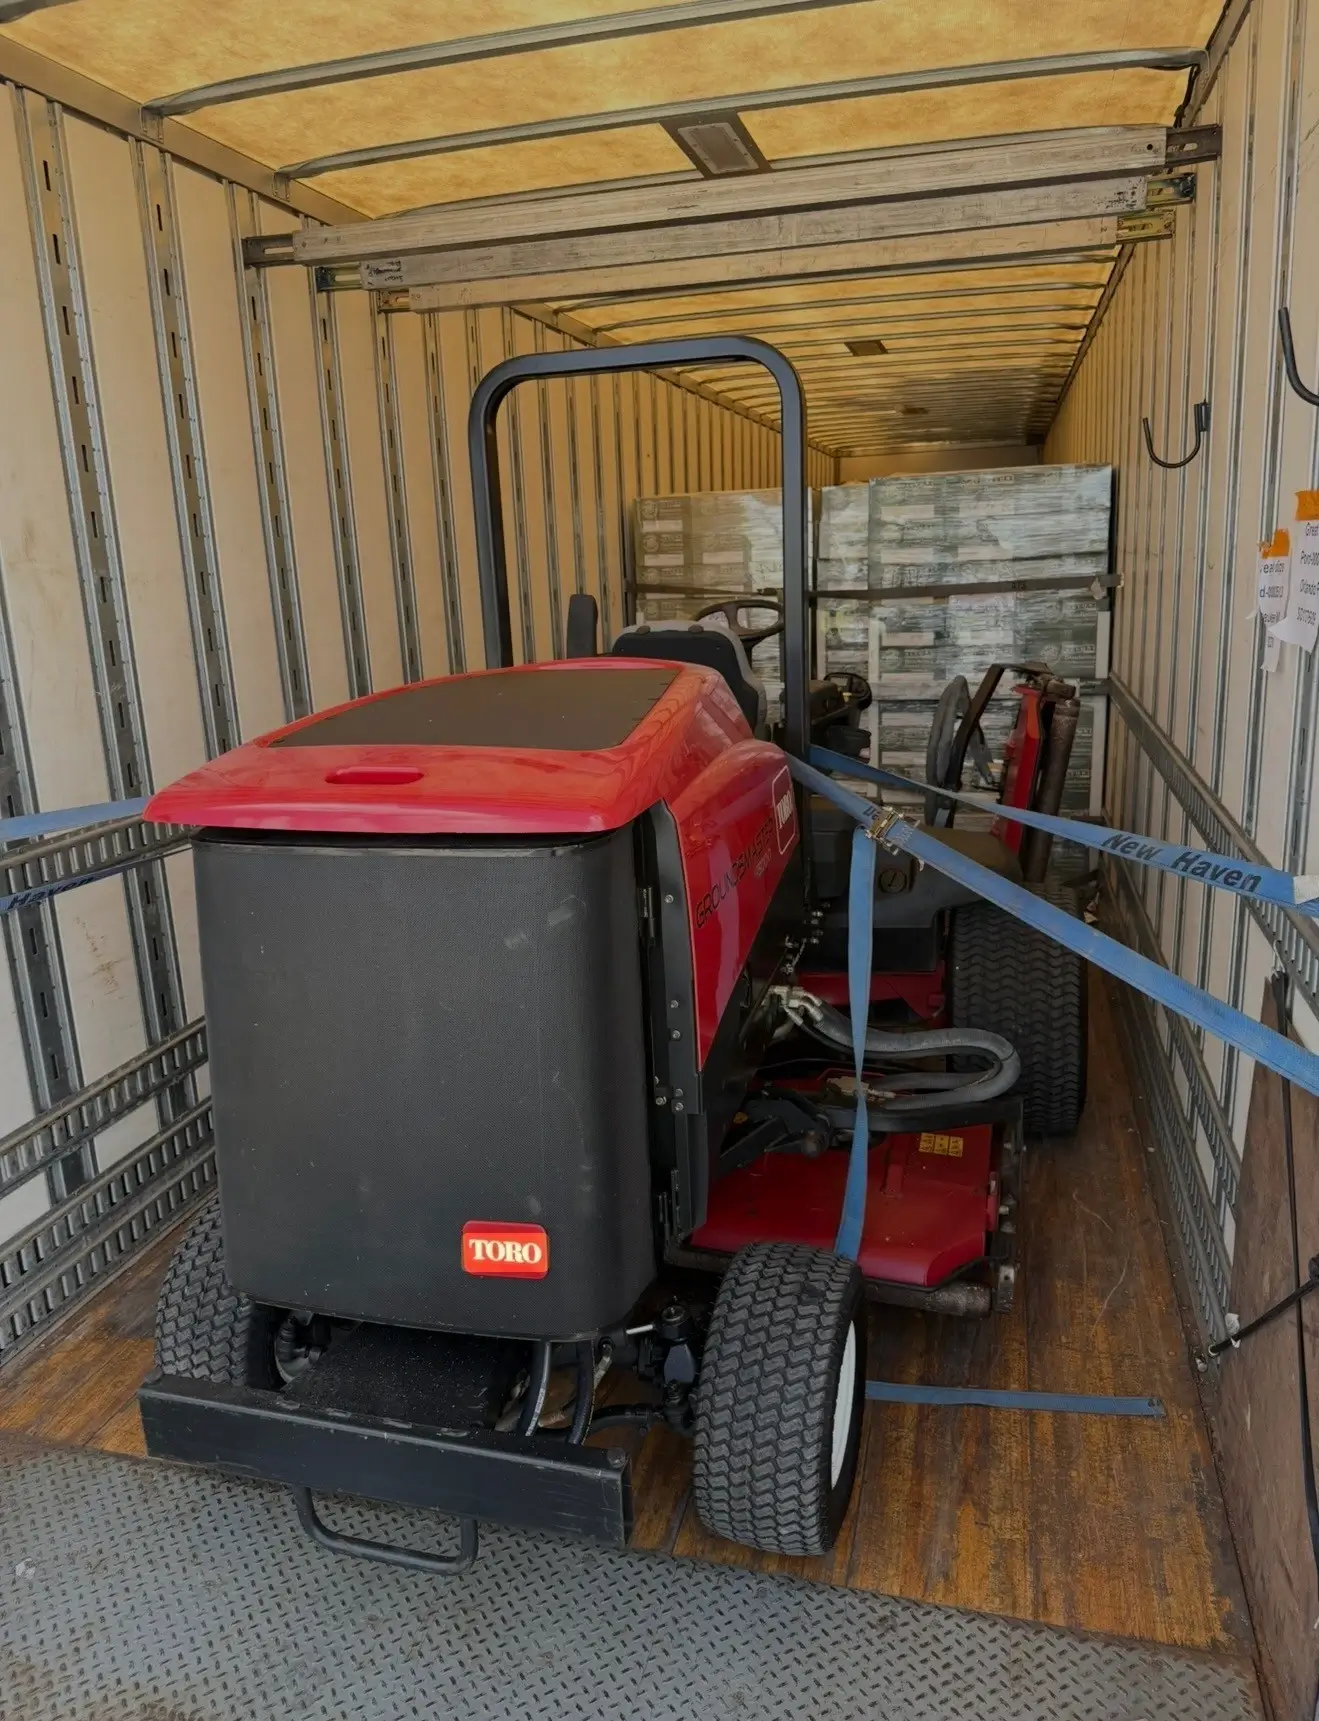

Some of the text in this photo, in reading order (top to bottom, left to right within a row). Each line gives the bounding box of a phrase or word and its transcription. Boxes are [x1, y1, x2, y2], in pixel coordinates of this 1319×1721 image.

[1101, 833, 1263, 893] New Haven
[468, 1239, 542, 1264] TORO
